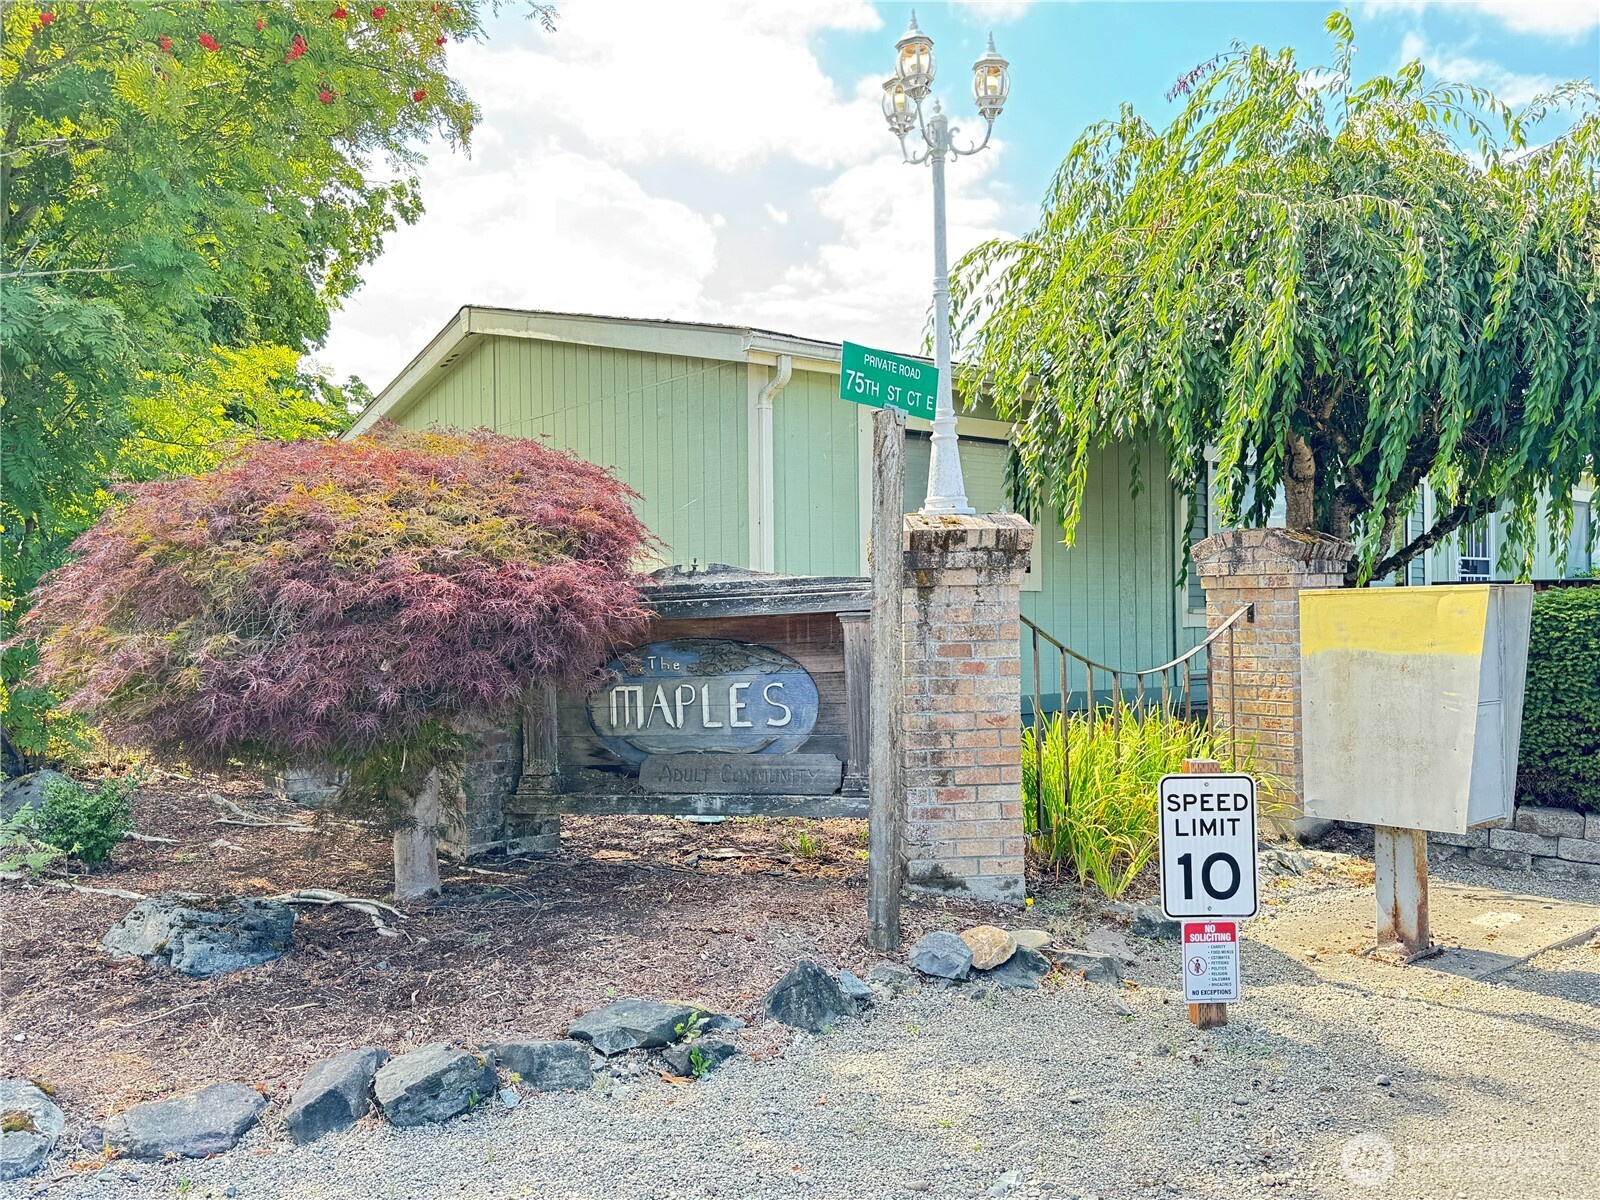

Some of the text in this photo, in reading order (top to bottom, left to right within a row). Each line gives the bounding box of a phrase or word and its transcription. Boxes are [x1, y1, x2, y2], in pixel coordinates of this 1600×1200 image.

[864, 354, 921, 380] PRIVATE ROAD
[846, 369, 934, 411] 75TH ST CT E
[647, 656, 680, 671] The
[609, 681, 792, 729] MAPLES
[657, 764, 711, 784] ADULT
[1167, 793, 1248, 812] SPEED
[1175, 818, 1241, 836] LIMIT
[1177, 852, 1241, 900] 10
[1190, 933, 1231, 941] SOLICITING
[1205, 924, 1215, 933] NO
